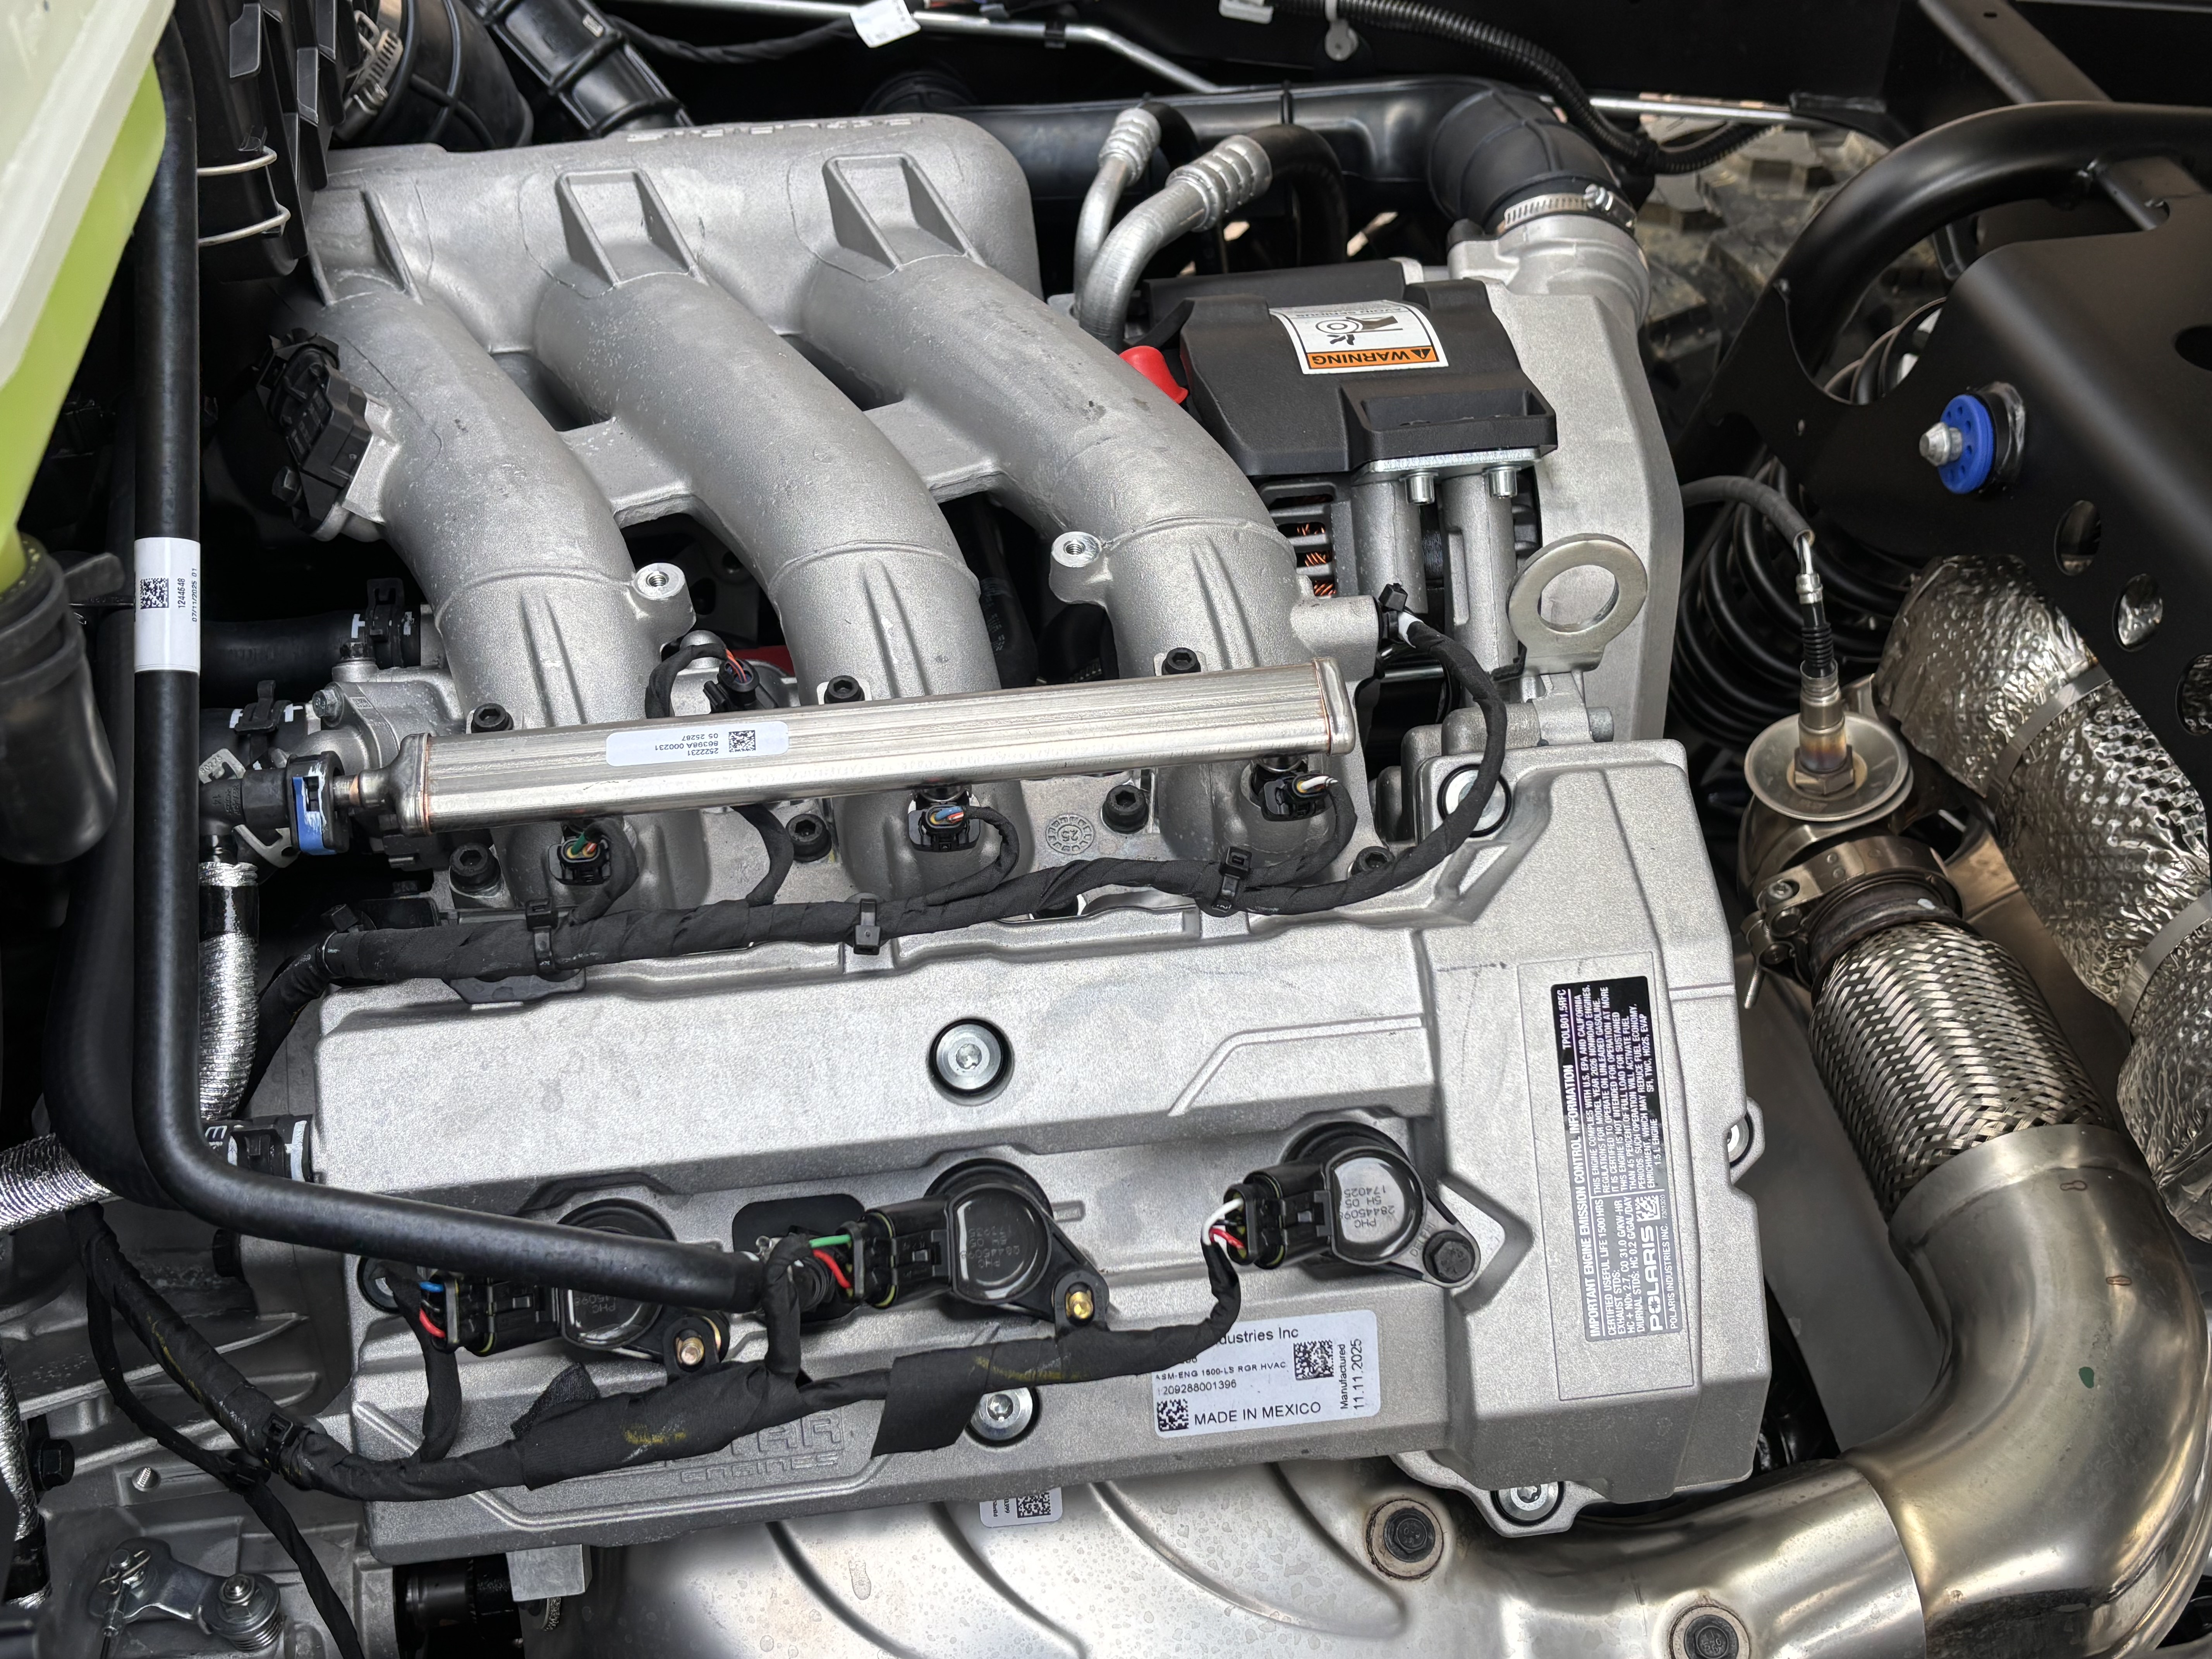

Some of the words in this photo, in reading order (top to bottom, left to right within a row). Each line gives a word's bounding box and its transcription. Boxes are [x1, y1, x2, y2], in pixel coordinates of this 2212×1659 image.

[1312, 351, 1409, 364] WARNING
[192, 568, 197, 577] 01
[177, 578, 185, 608] 1244648
[655, 743, 684, 751] 000231
[682, 733, 705, 742] 25287
[687, 748, 718, 756] 2522231
[1600, 986, 1610, 1008] MORE
[1574, 994, 1585, 1037] CALIFORNIA
[1602, 1010, 1611, 1020] AT
[1621, 1016, 1630, 1034] FUEL
[1639, 1013, 1648, 1032] EVAP
[1585, 1020, 1596, 1056] NONROAD
[1604, 1022, 1615, 1062] OPERATION
[1611, 1012, 1623, 1052] SUSTAINED
[1578, 1039, 1587, 1055] AND
[1596, 1037, 1607, 1075] UNLEADED
[1623, 1036, 1634, 1070] ACTIVATE
[1633, 1043, 1642, 1061] FUEL
[1580, 1056, 1589, 1070] EPA
[1589, 1058, 1598, 1076] 2026
[1608, 1064, 1616, 1079] FOR
[1616, 1054, 1625, 1069] FOR
[1591, 1078, 1601, 1097] YEAR
[1600, 1078, 1608, 1089] ON
[1618, 1070, 1626, 1090] LOAD
[1627, 1072, 1636, 1089] WILL
[1635, 1063, 1645, 1092] REDUCE
[1563, 1064, 1580, 1134] INFORMATION
[1583, 1089, 1592, 1108] WITH
[1602, 1090, 1612, 1123] OPERATE
[1610, 1081, 1620, 1117] INTENDED
[1620, 1092, 1628, 1110] FULL
[1638, 1094, 1647, 1110] MAY
[1594, 1099, 1603, 1124] MODEL
[1622, 1112, 1630, 1122] OF
[1629, 1091, 1640, 1132] OPERATION
[1585, 1109, 1596, 1146] COMPLIES
[1596, 1127, 1605, 1141] FOR
[1605, 1125, 1613, 1135] TO
[1614, 1119, 1622, 1134] NOT
[1640, 1113, 1650, 1137] WHICH
[1650, 1118, 1659, 1145] ENGINE
[1623, 1124, 1633, 1157] PERCENT
[1633, 1133, 1642, 1153] SUCH
[1570, 1136, 1585, 1183] CONTROL
[1589, 1148, 1599, 1175] ENGINE
[1607, 1137, 1617, 1173] CERTIFIED
[1616, 1146, 1626, 1172] ENGINE
[1627, 1159, 1635, 1168] 45
[1653, 1154, 1662, 1165] 1.5
[1598, 1143, 1610, 1193] REGULATIONS
[1592, 1177, 1601, 1194] THIS
[1620, 1174, 1628, 1191] THIS
[1628, 1170, 1637, 1190] THAN
[1344, 1185, 1386, 1198] 174025
[1367, 1195, 1382, 1205] 5H
[1345, 1198, 1359, 1208] 05
[1575, 1186, 1590, 1235] EMISSION
[1595, 1199, 1604, 1216] HRS
[1354, 1219, 1376, 1228] PHC
[1597, 1217, 1606, 1237] 1500
[1614, 1200, 1626, 1237] G/KW-HR
[1623, 1196, 1635, 1239] G/GAL/DAY
[1660, 1223, 1669, 1240] INC.
[1580, 1237, 1594, 1274] ENGINE
[1599, 1239, 1608, 1257] LIFE
[1618, 1240, 1628, 1258] 31.0
[1628, 1241, 1637, 1254] 0.2
[1620, 1260, 1629, 1272] CO
[1630, 1256, 1638, 1268] HC
[1662, 1241, 1674, 1291] INDUSTRIES
[1601, 1259, 1612, 1291] USEFUL
[1612, 1269, 1622, 1294] STDS:
[1631, 1270, 1641, 1295] STDS:
[1640, 1225, 1663, 1331] POLARIS
[591, 1304, 616, 1313] PHC
[1585, 1277, 1600, 1336] IMPORTANT
[1604, 1293, 1616, 1335] CERTIFIED
[1614, 1296, 1626, 1334] EXHAUST
[1634, 1297, 1645, 1332] DIURNAL
[1667, 1292, 1678, 1329] POLARIS
[1279, 1327, 1299, 1339] Inc
[1626, 1321, 1635, 1333] HC
[1155, 1370, 1199, 1381] ASM-ENG
[1238, 1364, 1257, 1372] RGR
[1261, 1361, 1286, 1370] HVAC
[1340, 1344, 1349, 1410] Manufactured
[1350, 1338, 1364, 1410] 11.11.2025
[1194, 1410, 1238, 1425] MADE
[1243, 1408, 1257, 1420] IN
[1262, 1401, 1321, 1418] MEXICO
